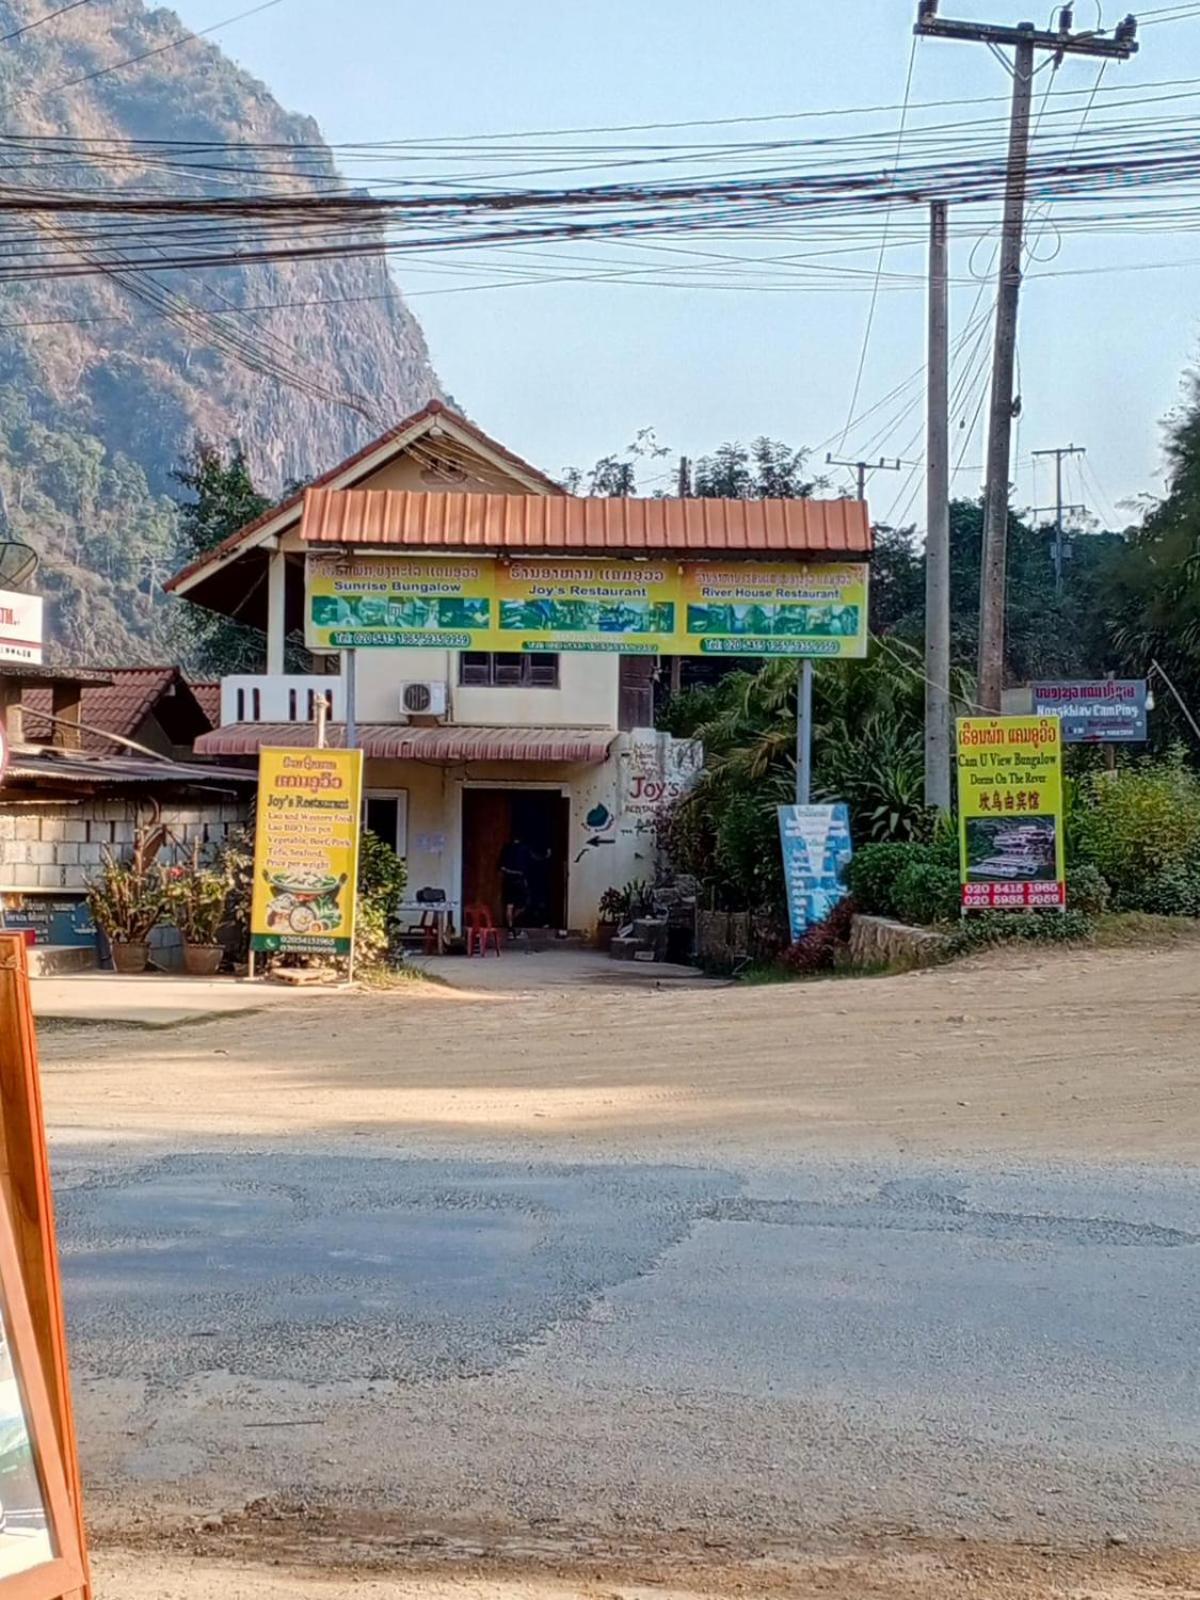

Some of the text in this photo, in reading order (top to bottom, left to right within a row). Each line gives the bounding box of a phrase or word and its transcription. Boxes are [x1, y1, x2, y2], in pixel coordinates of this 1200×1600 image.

[334, 581, 461, 593] Sunrise Bungalow
[529, 585, 646, 597] Joy's Restaurant
[702, 587, 840, 599] River House Restaurant
[958, 752, 1056, 769] Cam U View Bungalow
[995, 773, 1007, 784] On
[1008, 772, 1023, 784] The
[630, 776, 679, 802] Joy's
[267, 795, 349, 810] Joy's Restaurant
[284, 813, 299, 821] and
[287, 860, 301, 869] per
[964, 882, 1058, 894] 020 5415 1965
[964, 895, 990, 905] 020
[993, 895, 1024, 905] 5935
